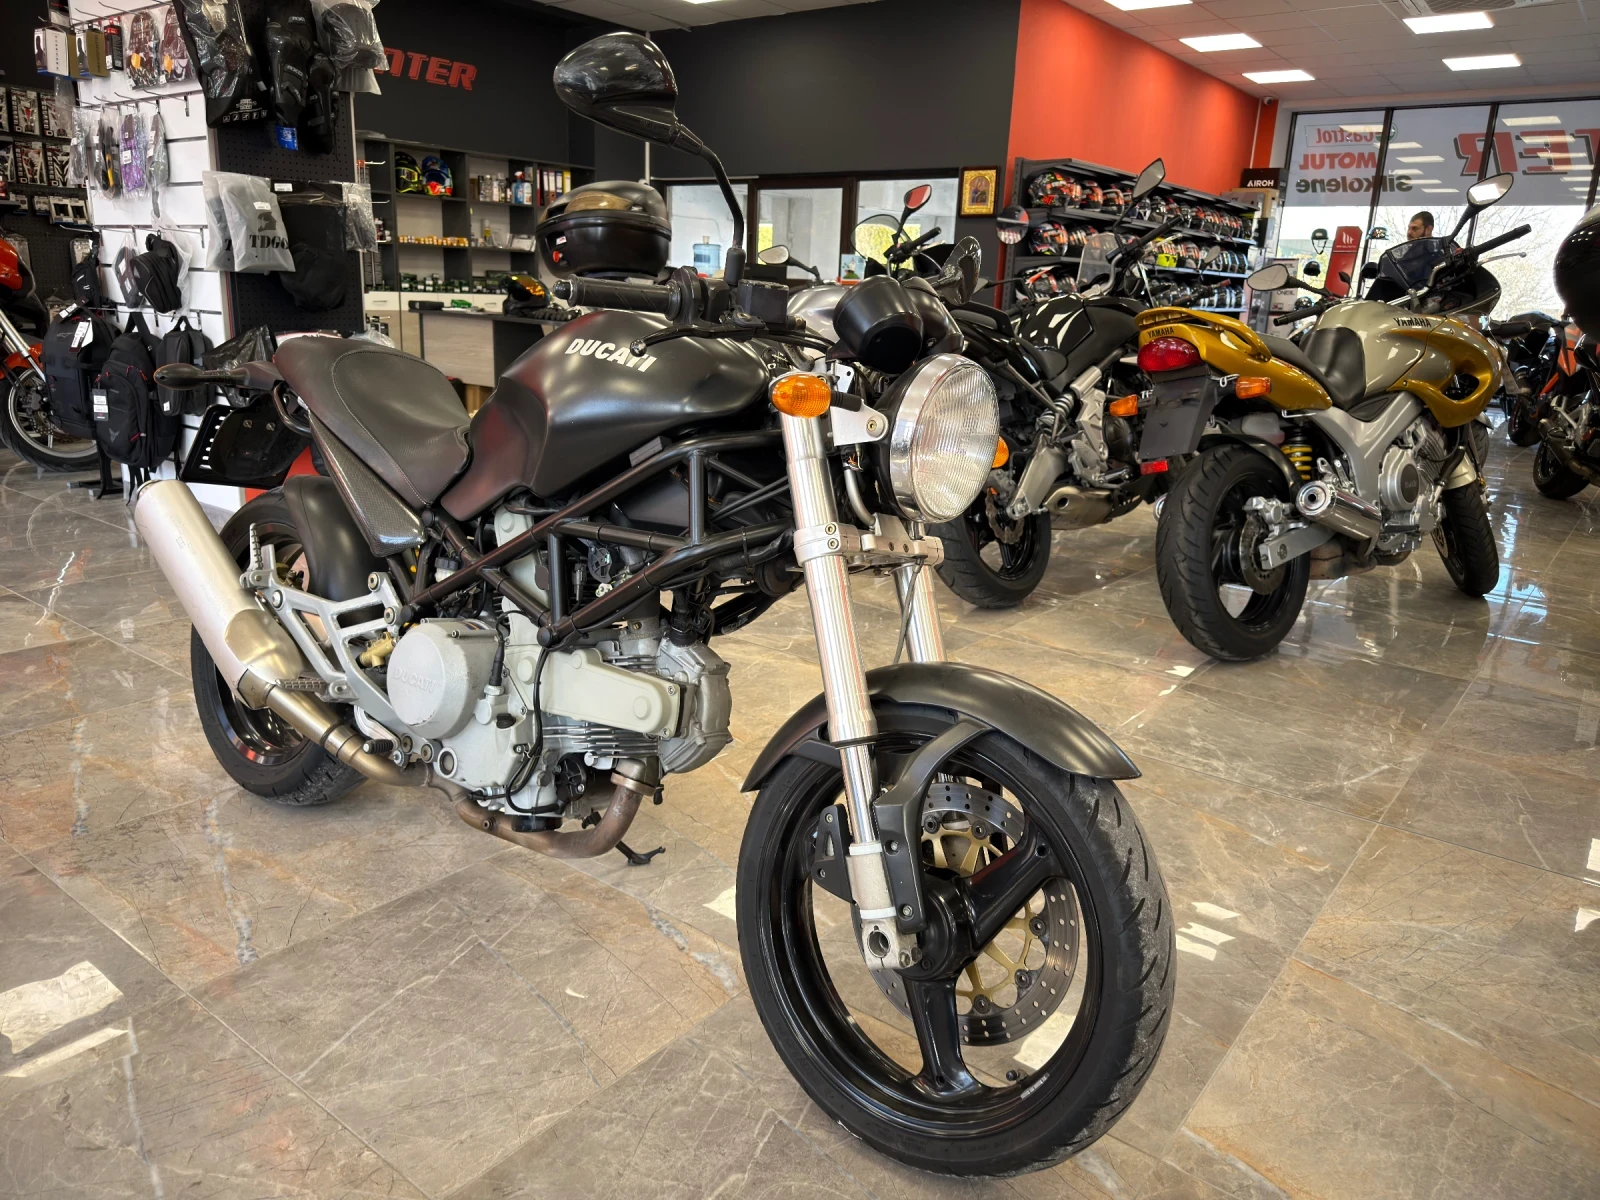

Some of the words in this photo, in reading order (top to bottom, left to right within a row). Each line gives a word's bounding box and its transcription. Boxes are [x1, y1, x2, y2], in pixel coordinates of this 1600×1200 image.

[1393, 317, 1432, 328] YAMAHA
[1146, 327, 1175, 338] YAMAHA
[565, 338, 657, 373] DUCATI
[393, 667, 437, 694] DUCATI
